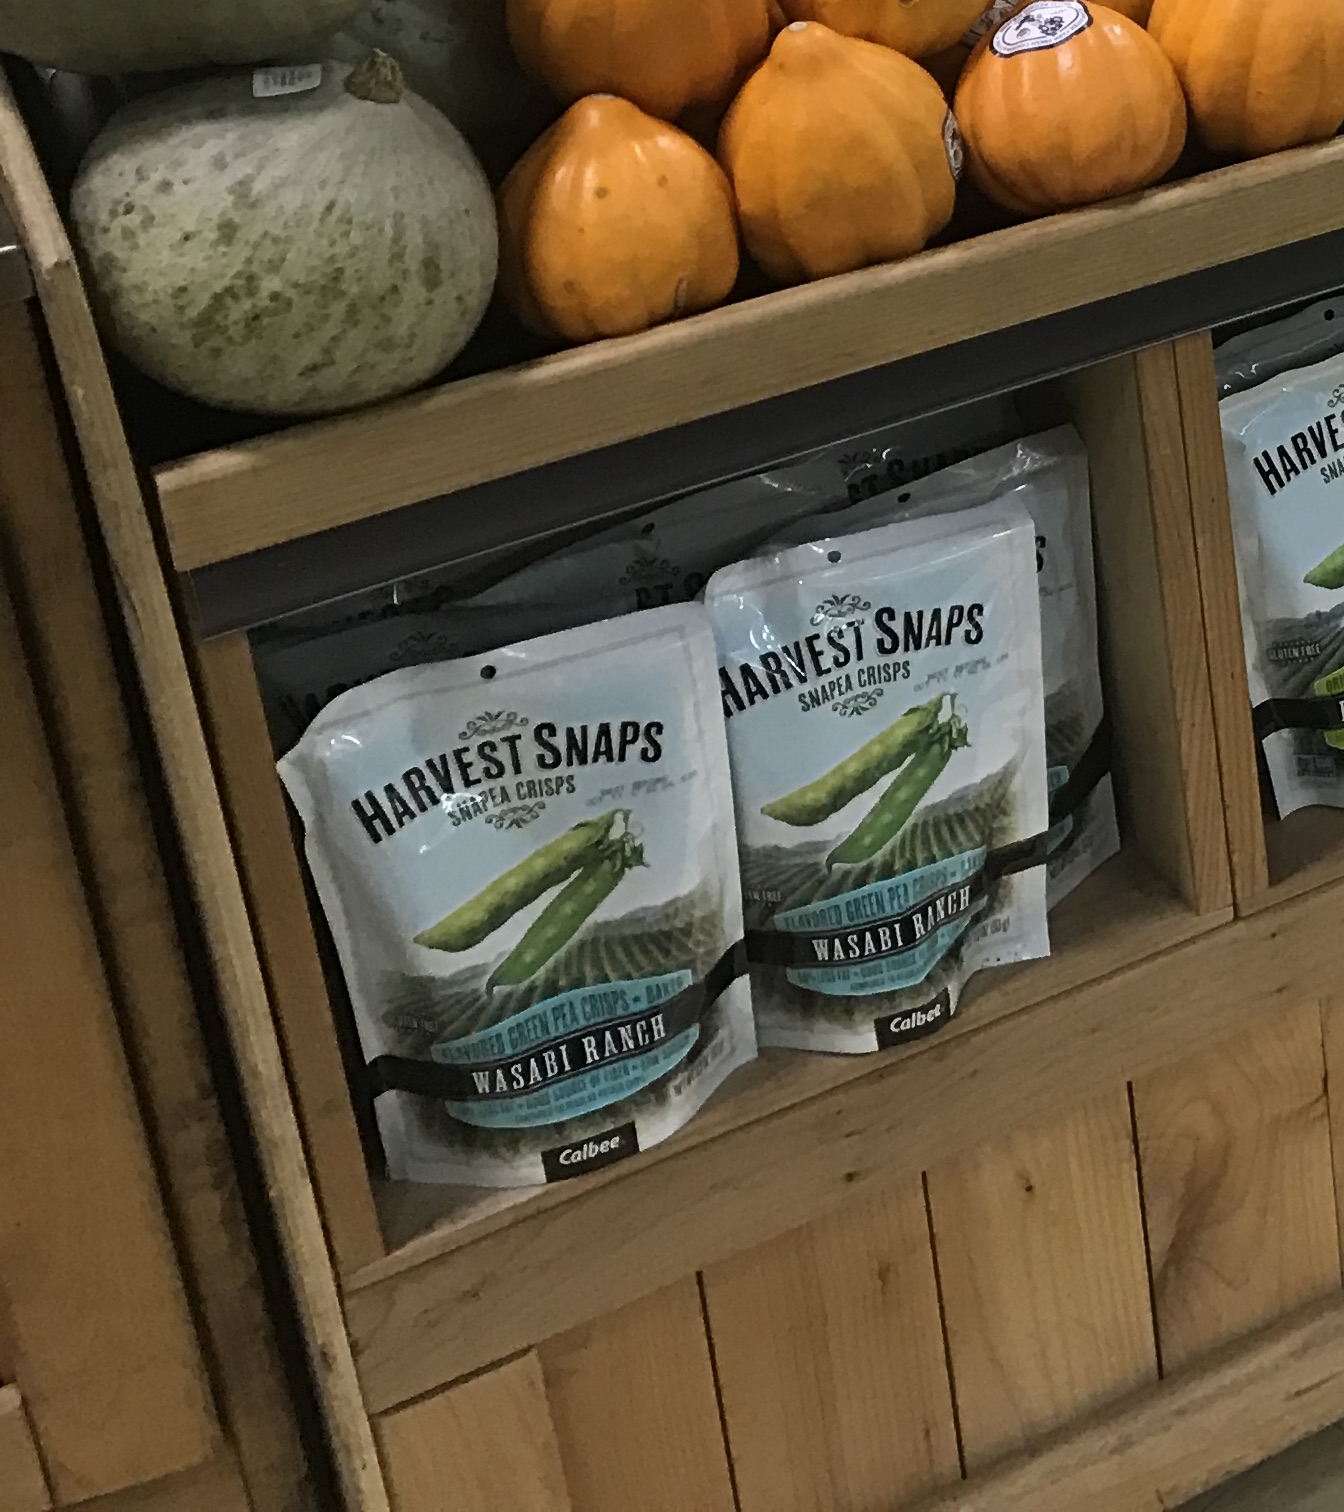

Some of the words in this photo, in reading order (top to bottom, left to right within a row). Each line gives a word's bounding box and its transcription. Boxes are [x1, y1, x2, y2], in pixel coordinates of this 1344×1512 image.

[874, 603, 985, 655] SNAPS
[798, 673, 855, 712] SNAPEA
[857, 660, 911, 687] CRISPS
[351, 734, 523, 844] HARVEST
[533, 721, 664, 770] SNAPS
[516, 774, 577, 802] CRISPS
[812, 922, 904, 963] WASABI
[913, 885, 972, 939] RANCH
[471, 1043, 573, 1095] WASABI
[581, 1013, 667, 1065] RANCH
[558, 1134, 621, 1167] Calbee
